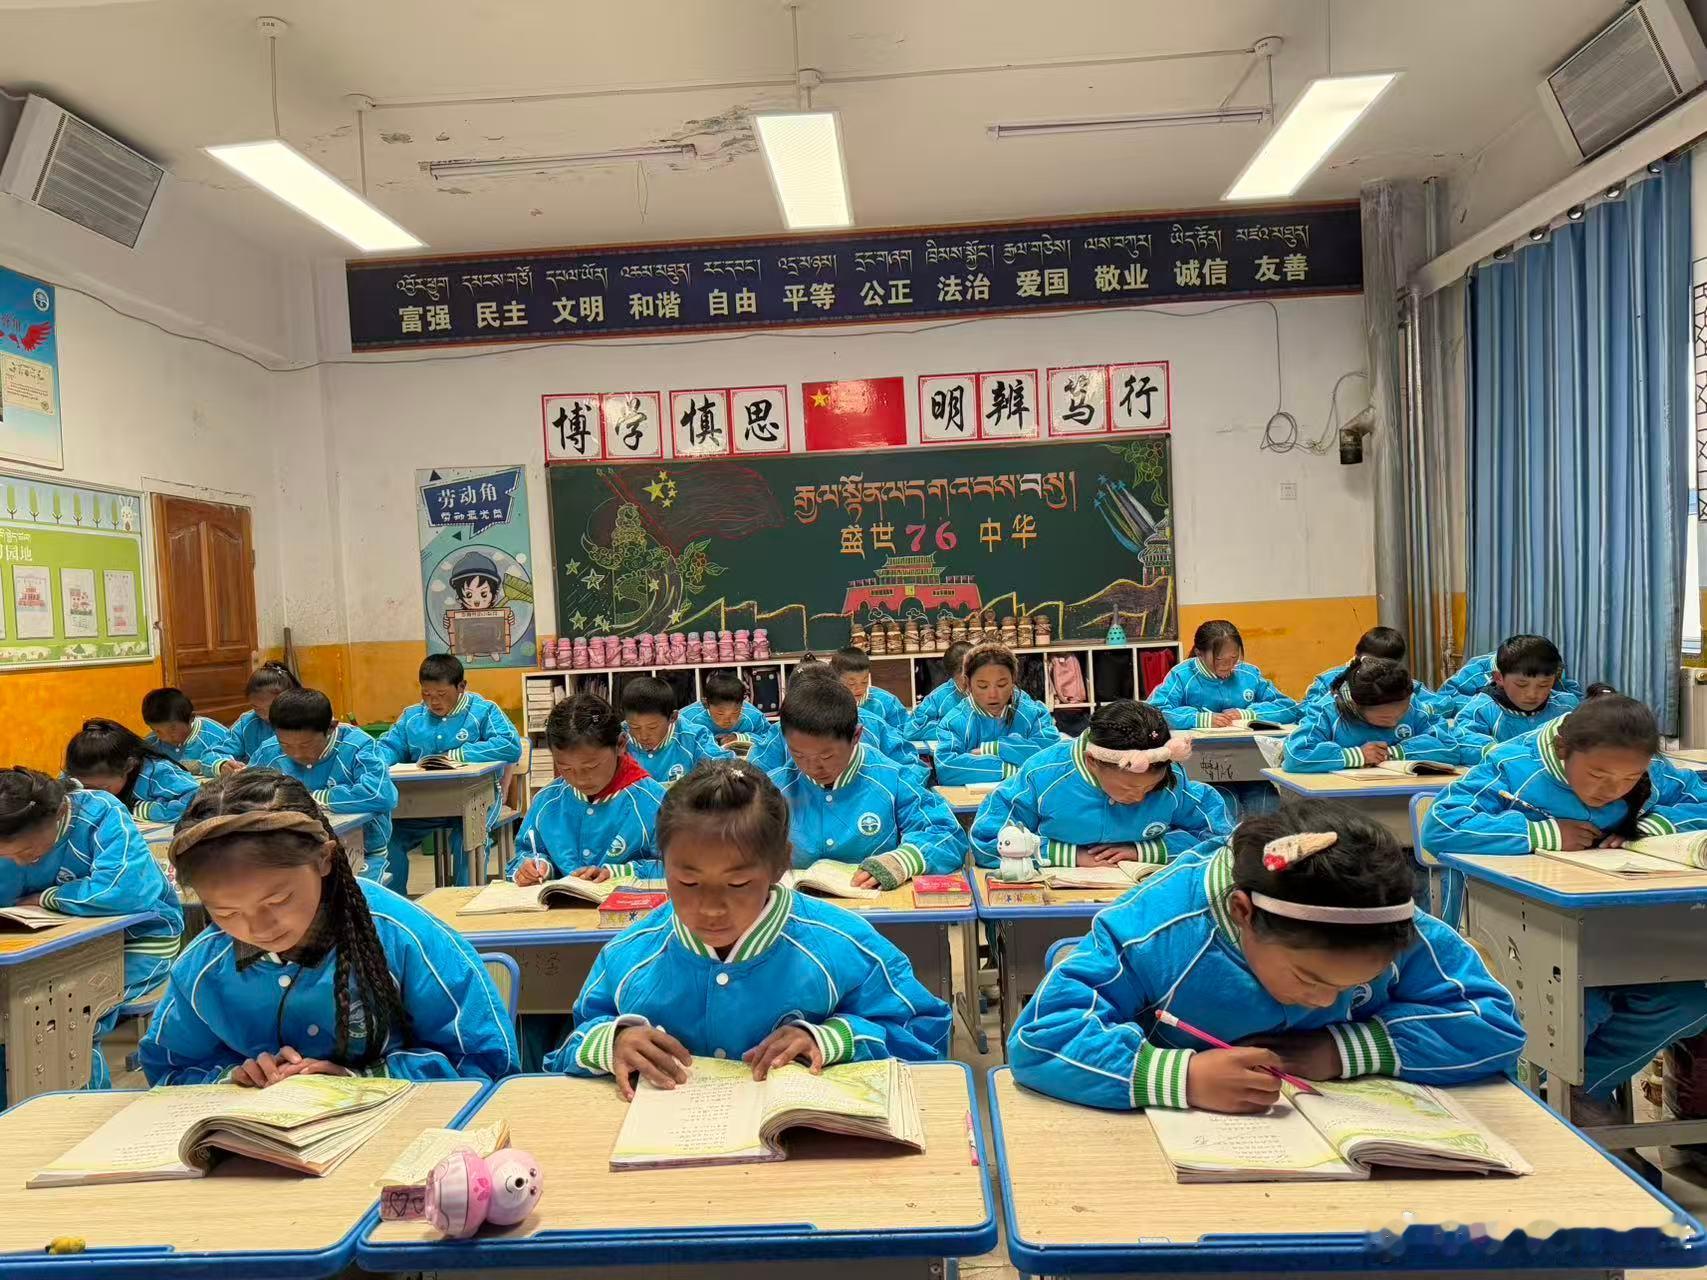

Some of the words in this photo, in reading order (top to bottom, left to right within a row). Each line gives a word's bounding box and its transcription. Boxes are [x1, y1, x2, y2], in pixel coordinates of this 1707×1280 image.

[398, 304, 452, 333] 富强
[476, 300, 528, 329] 民主
[552, 296, 605, 324] 文明
[629, 290, 681, 320] 和谐
[708, 287, 757, 316] 自由
[783, 282, 836, 311] 平等
[859, 279, 913, 307] 公正
[937, 272, 991, 302] 法治
[1016, 267, 1069, 297] 爱国
[1094, 263, 1149, 292] 敬业
[1173, 257, 1228, 287] 诚信
[1254, 253, 1309, 282] 友善
[552, 394, 647, 455] 博学
[680, 394, 780, 447] 慎思
[931, 378, 1030, 432] 明辨
[1062, 374, 1158, 426] 笃行
[438, 482, 497, 510] 劳动角
[0, 543, 32, 561] 园地
